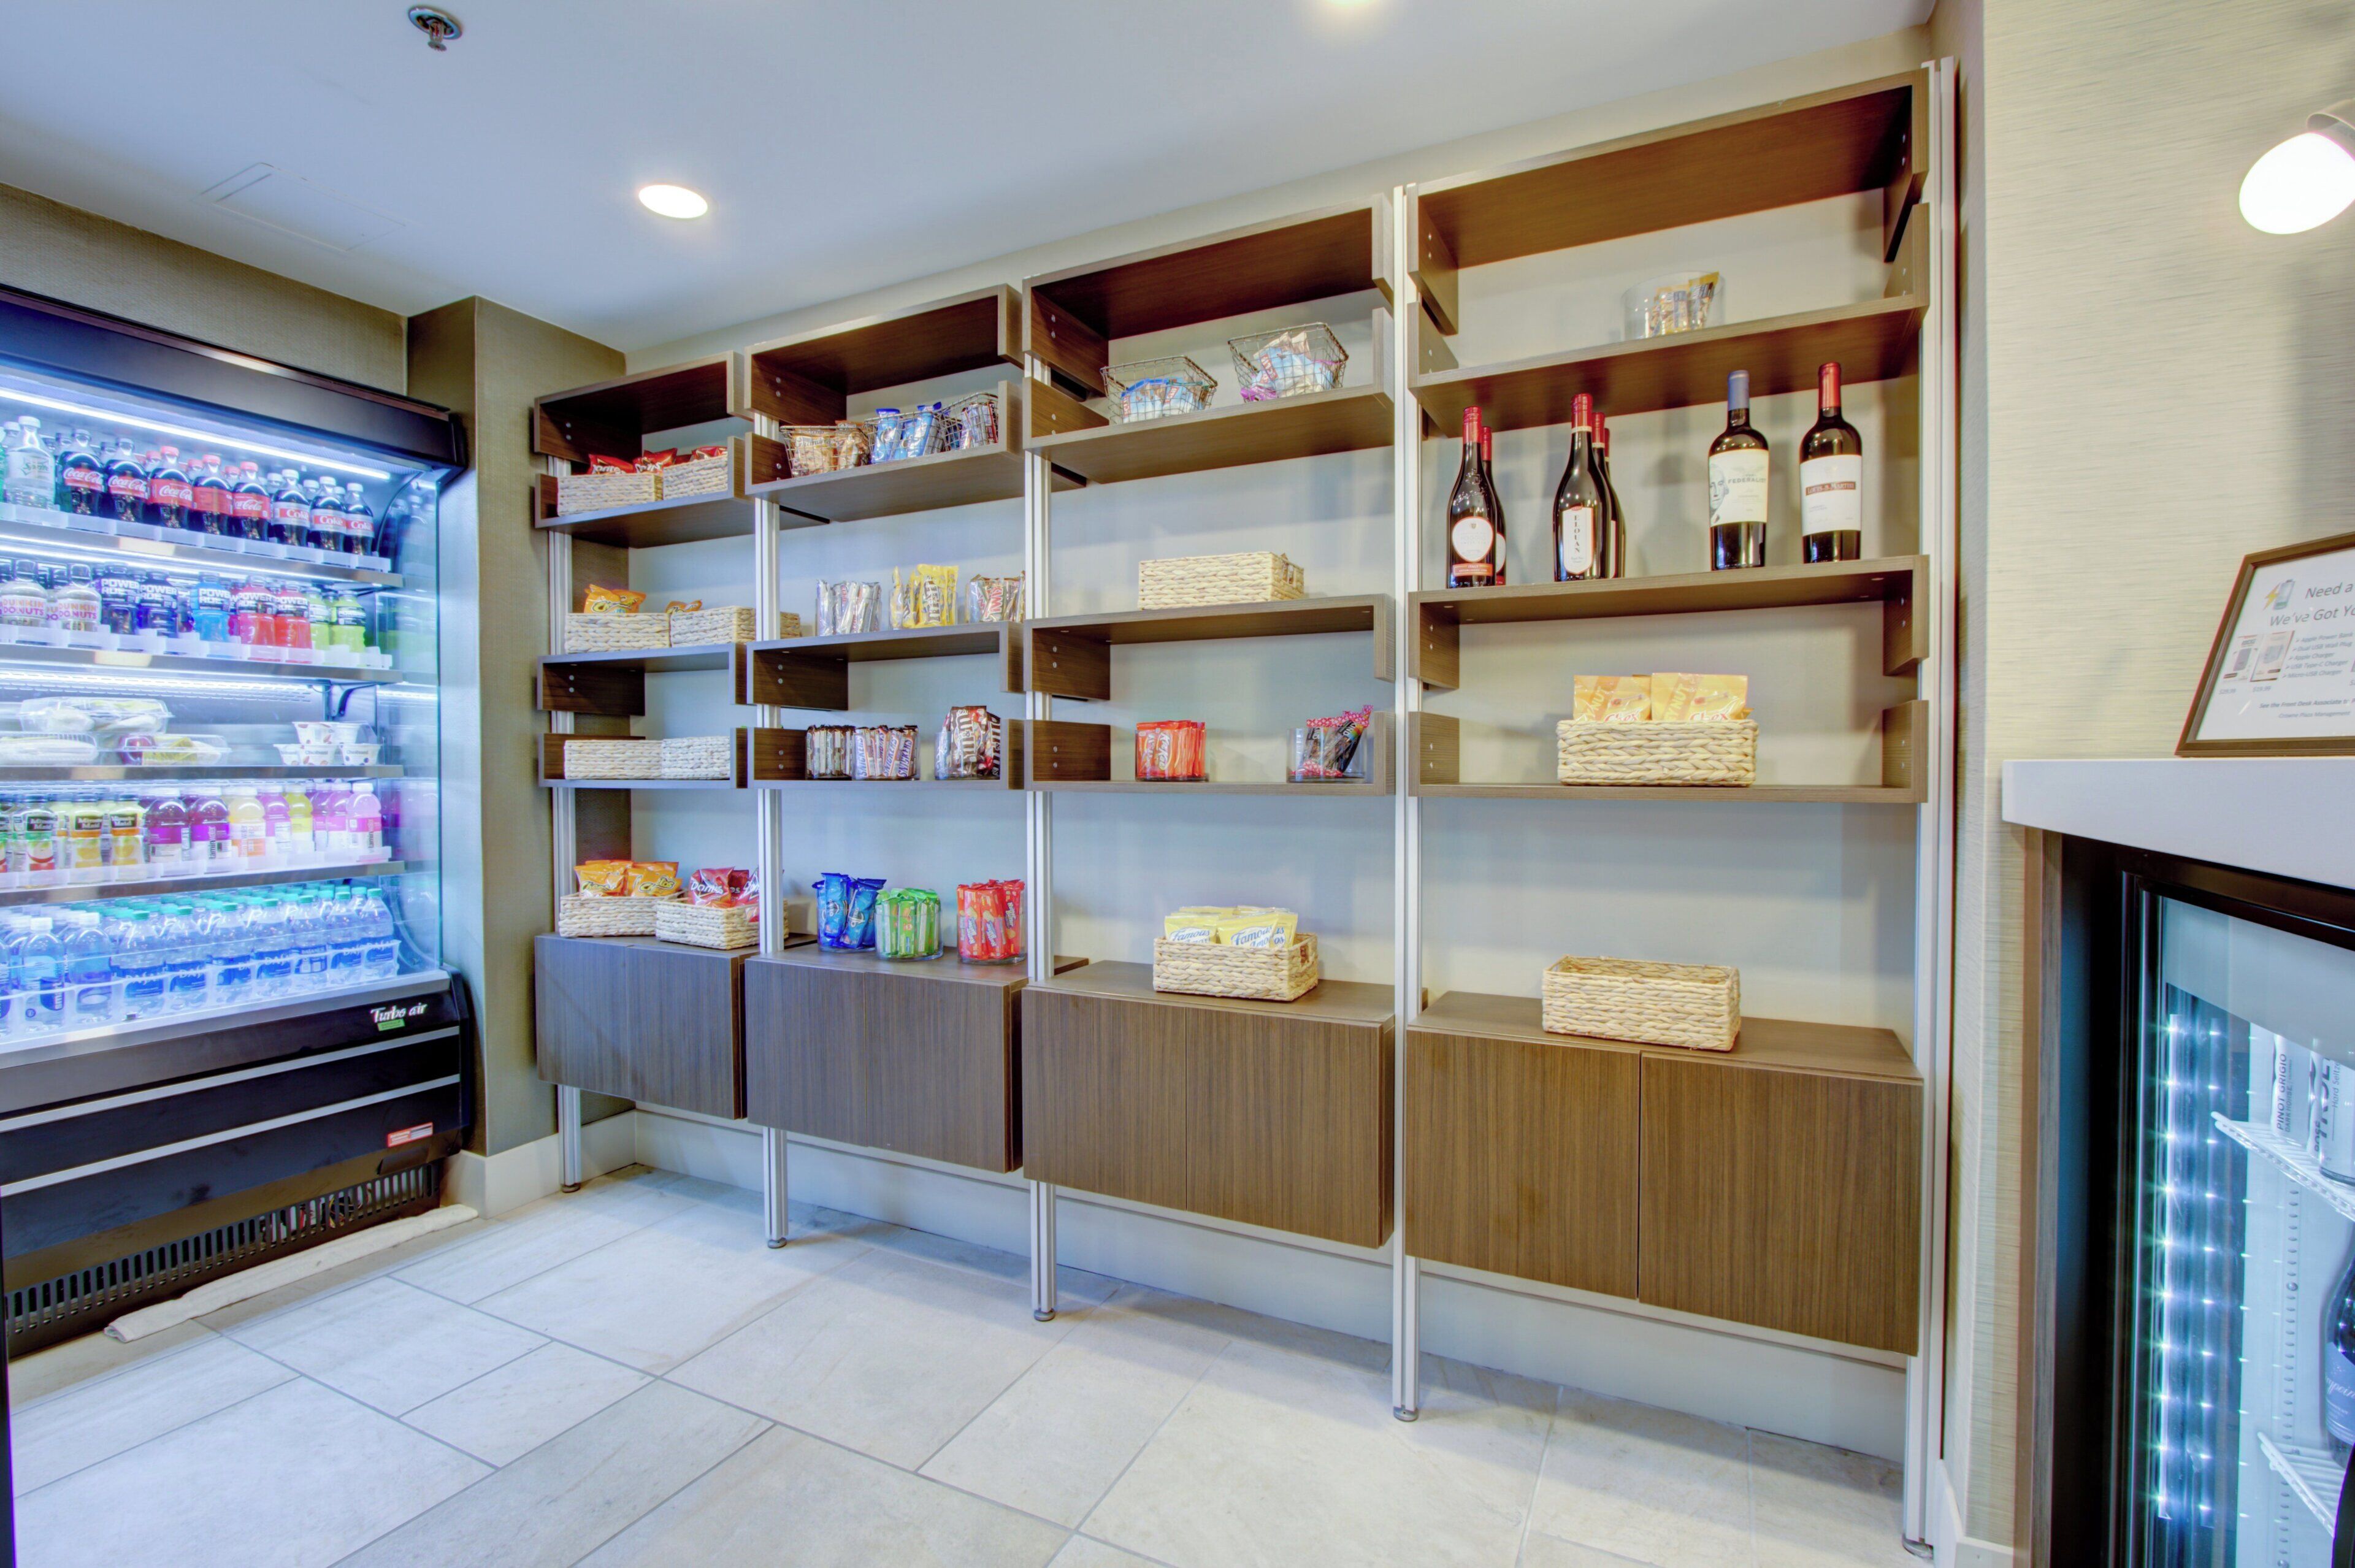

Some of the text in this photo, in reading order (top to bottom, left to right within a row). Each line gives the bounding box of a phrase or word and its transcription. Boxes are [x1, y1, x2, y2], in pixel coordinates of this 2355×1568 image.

[159, 485, 193, 502] Coca-Col
[140, 584, 177, 595] POWER
[2305, 582, 2354, 599] Need a
[3, 606, 44, 616] DONUTS
[2313, 609, 2339, 621] Got
[1170, 928, 1210, 942] Famous
[1231, 925, 1273, 946] Famous
[370, 1002, 428, 1023] Turbo air
